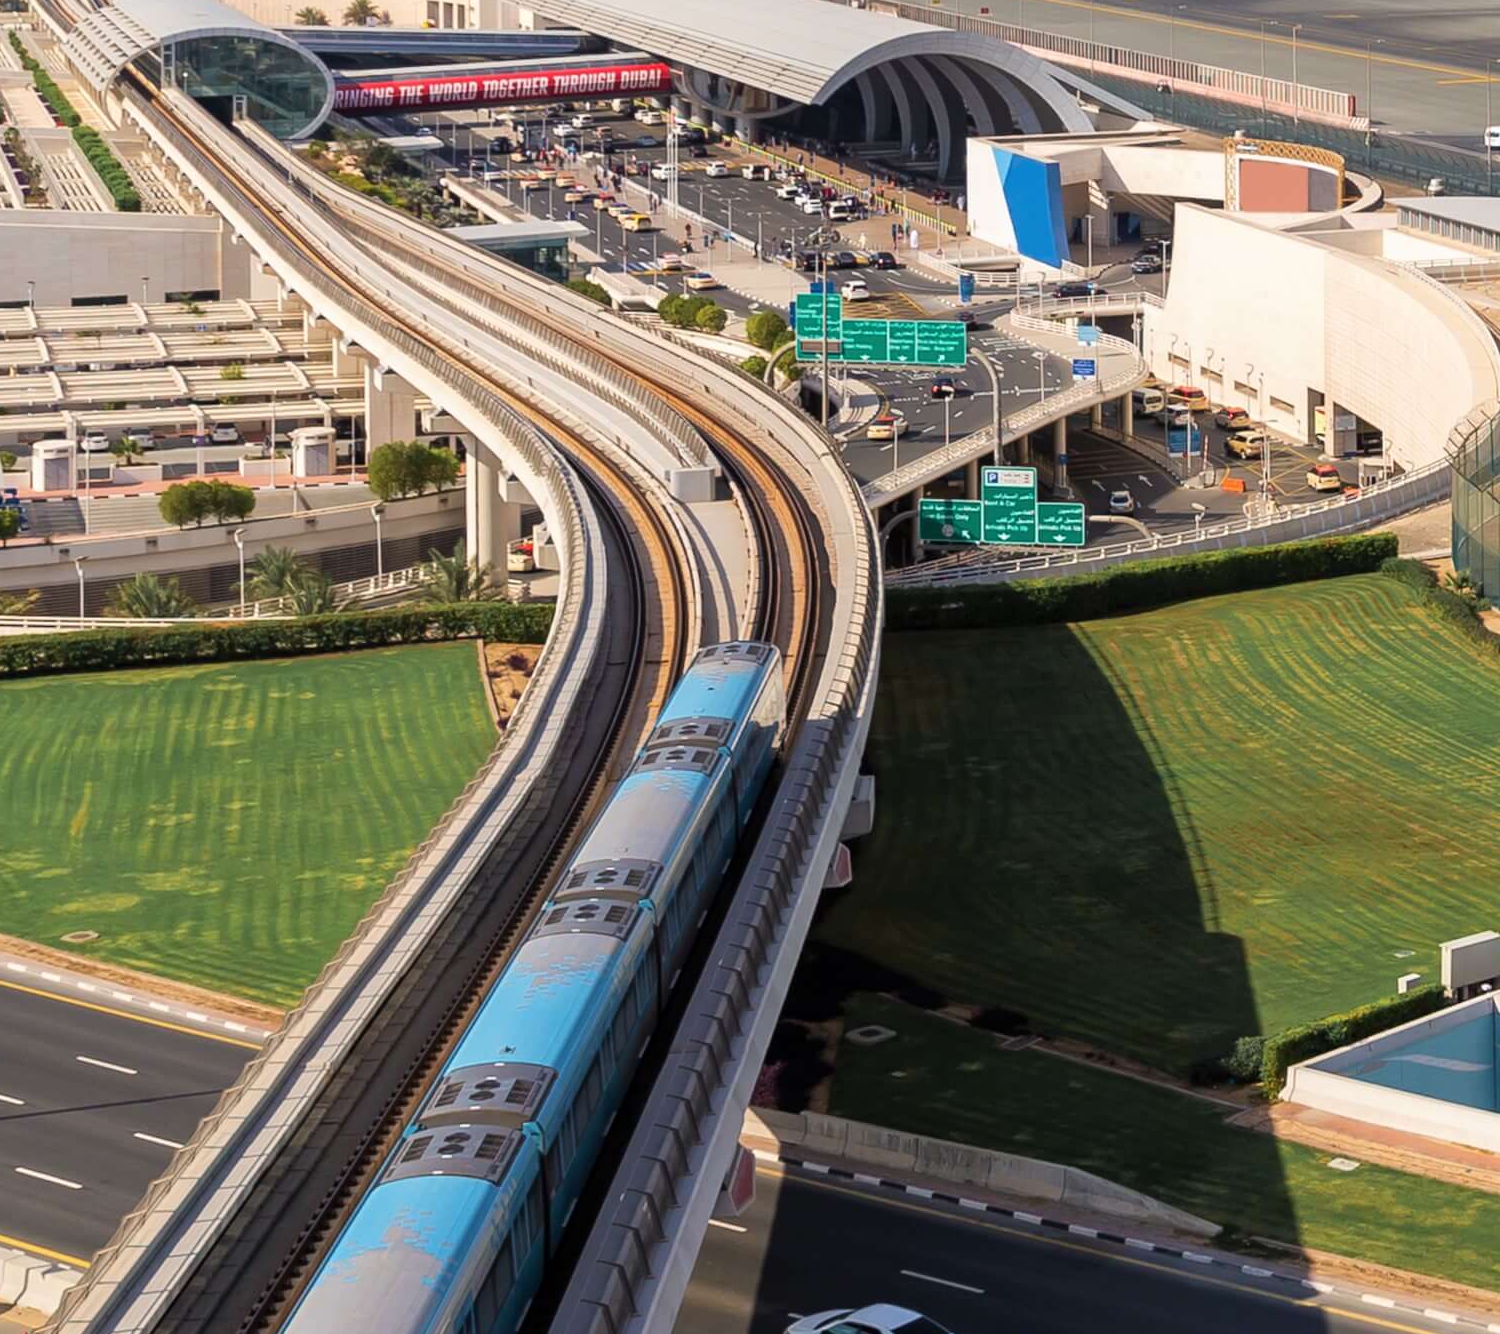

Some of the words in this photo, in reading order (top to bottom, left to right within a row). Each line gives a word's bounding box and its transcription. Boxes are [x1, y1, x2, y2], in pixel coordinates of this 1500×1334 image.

[335, 87, 394, 109] RINGING
[399, 85, 423, 105] THE
[429, 80, 478, 103] WORLD
[483, 75, 549, 100] TOGETHER
[553, 72, 616, 95] THROUGH
[620, 69, 663, 90] DUBAI
